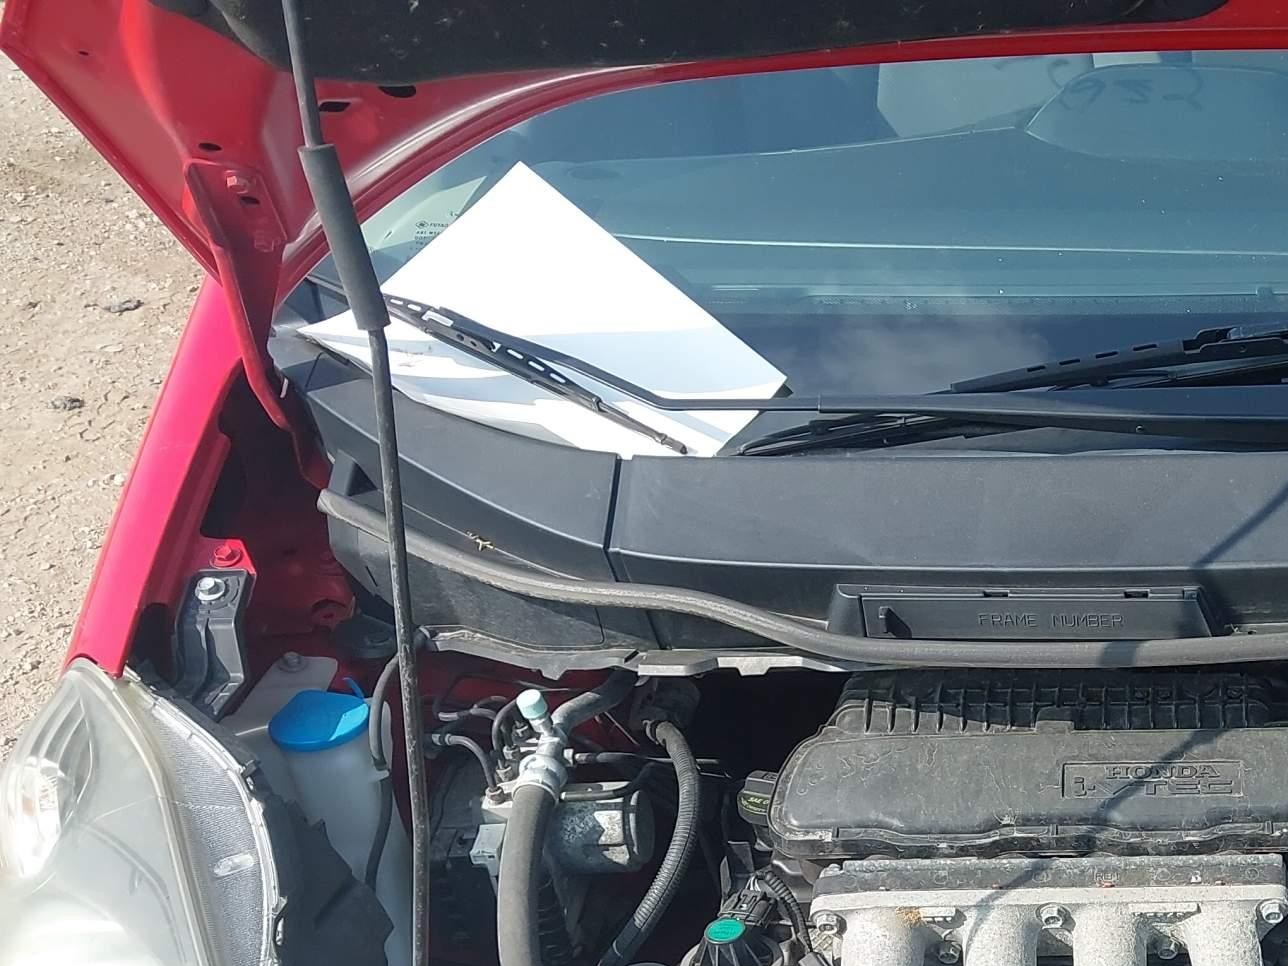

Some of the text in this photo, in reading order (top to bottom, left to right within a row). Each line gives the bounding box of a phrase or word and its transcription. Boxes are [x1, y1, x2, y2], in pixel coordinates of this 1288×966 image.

[978, 612, 1125, 629] FRAME NUMBER
[1105, 764, 1221, 780] HONDA
